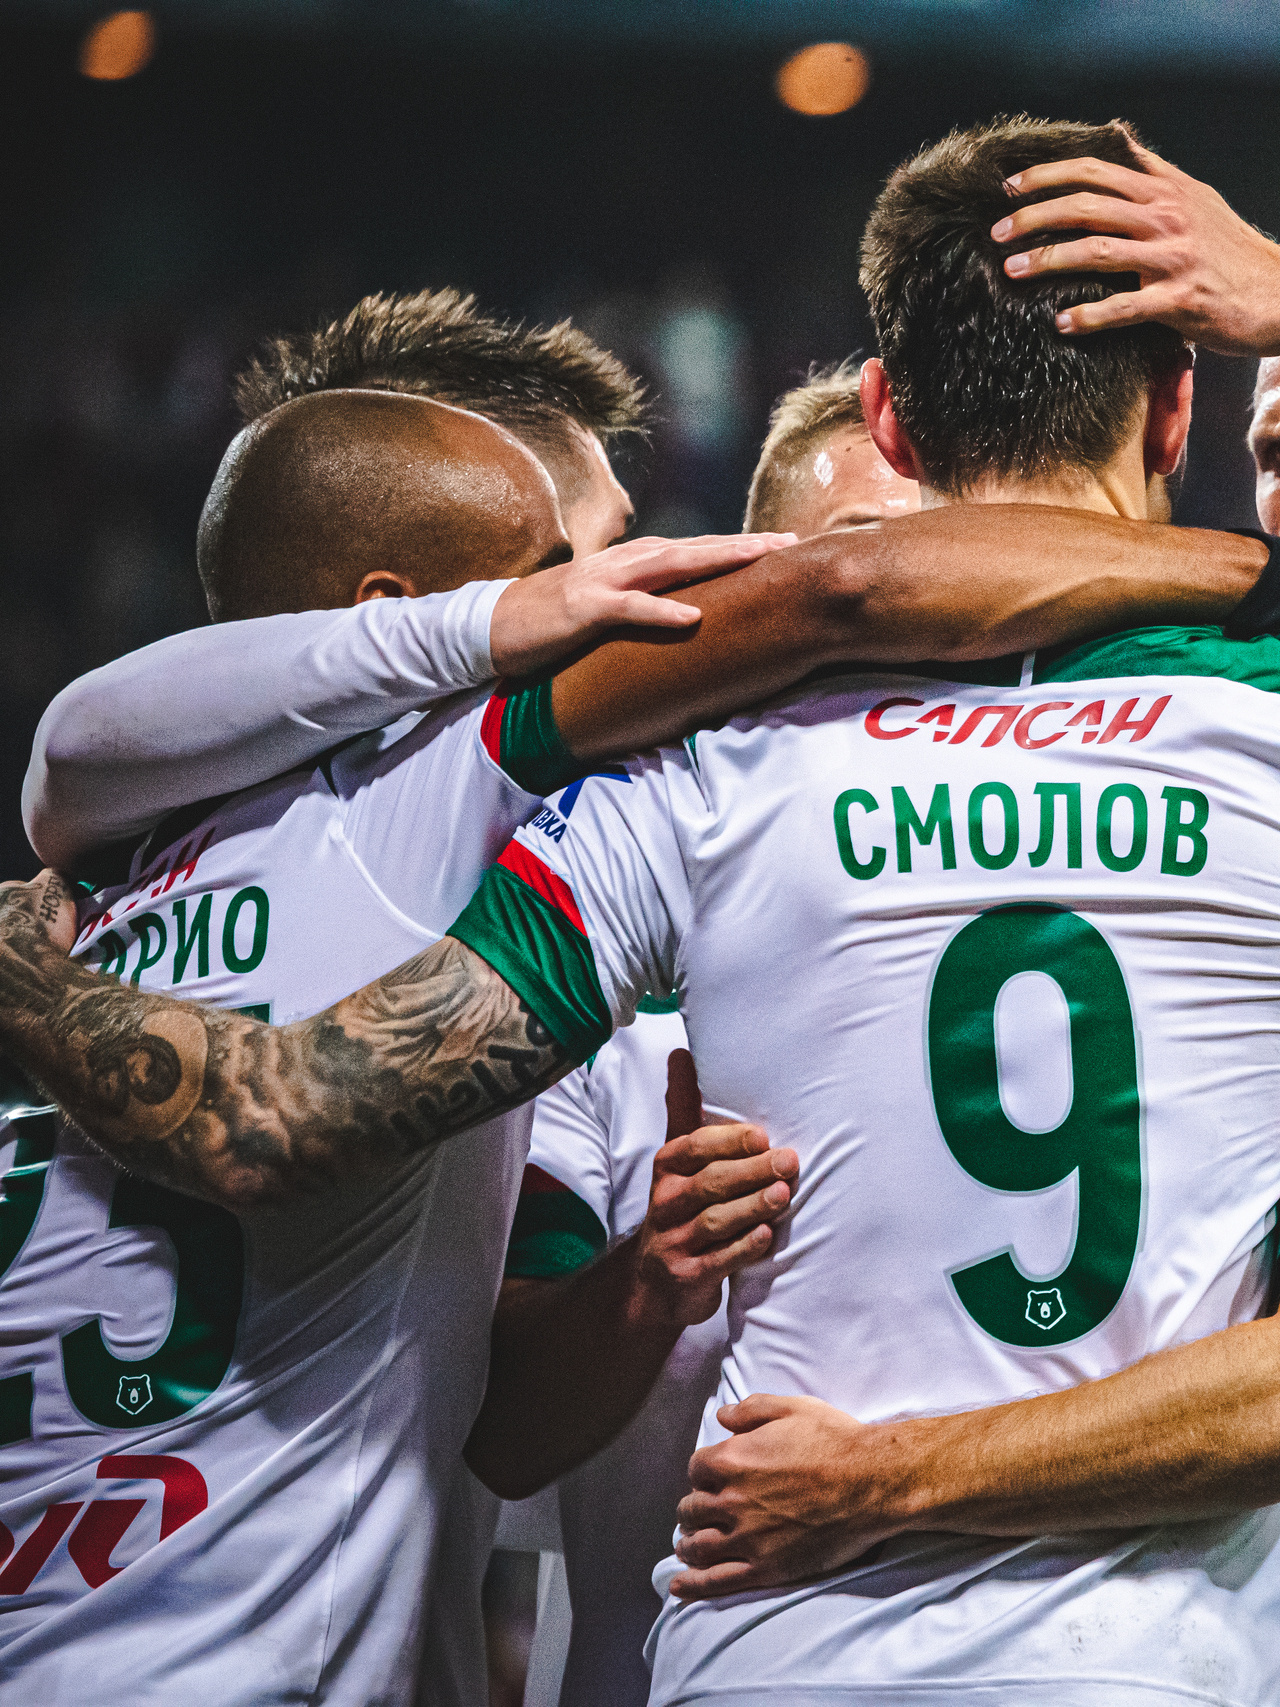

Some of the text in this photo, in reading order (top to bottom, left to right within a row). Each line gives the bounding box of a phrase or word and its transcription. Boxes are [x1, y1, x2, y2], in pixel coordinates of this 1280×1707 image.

[864, 694, 1174, 750] САПСАН
[833, 781, 1210, 880] СМОЛОВ
[96, 885, 270, 985] АРИО
[926, 901, 1144, 1349] 9
